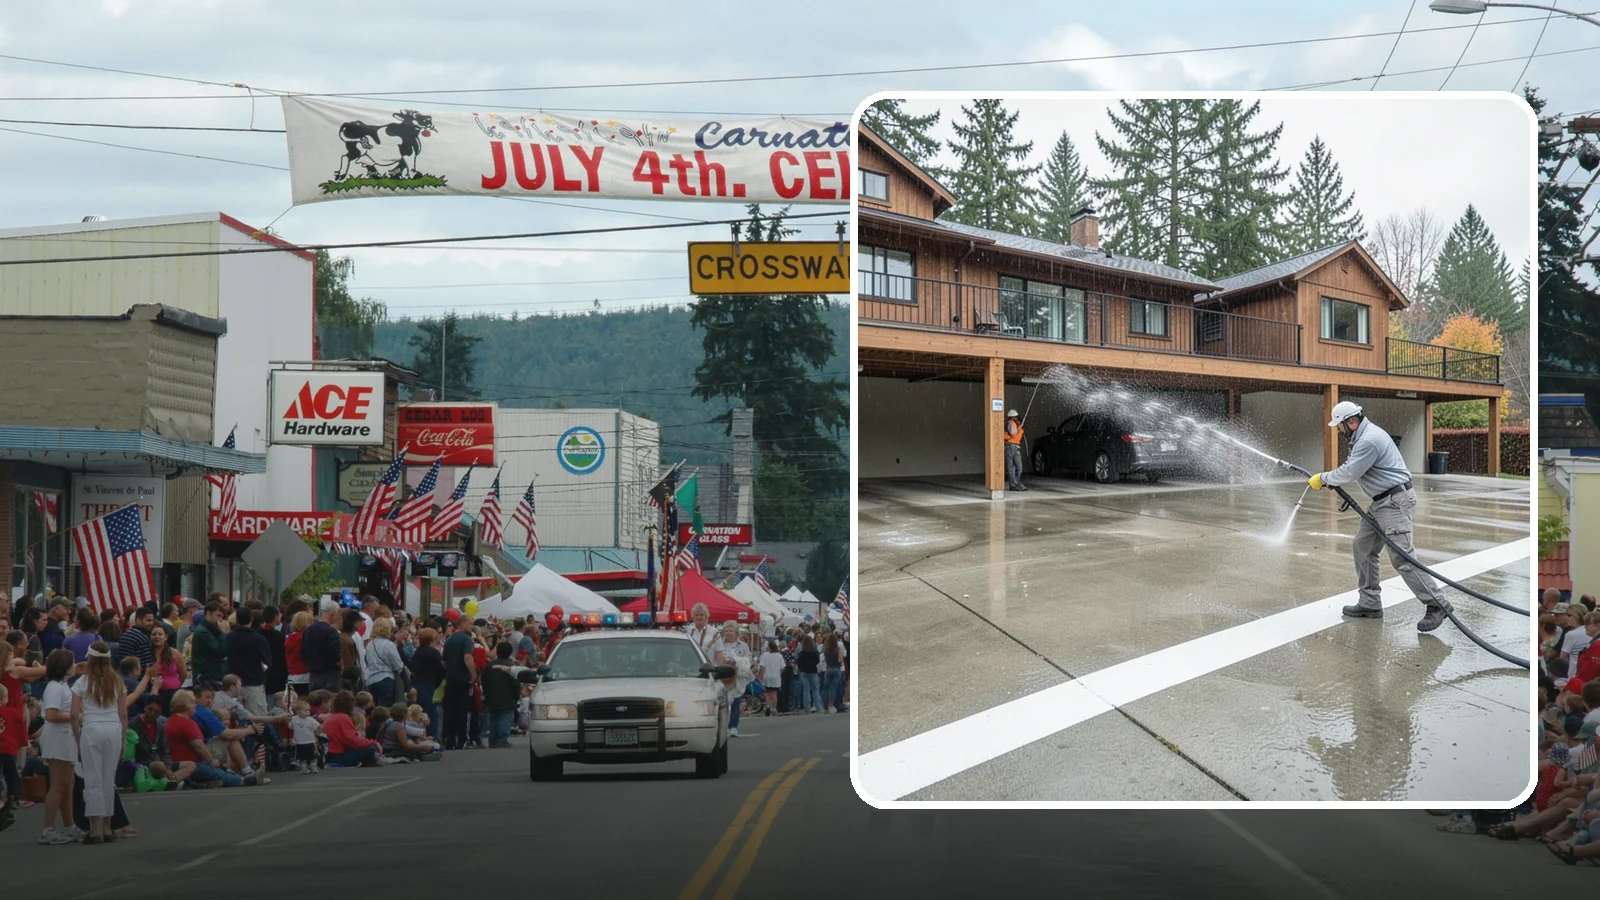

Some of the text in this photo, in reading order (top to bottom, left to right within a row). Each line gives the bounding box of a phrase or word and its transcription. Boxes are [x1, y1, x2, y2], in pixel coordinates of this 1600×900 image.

[695, 121, 850, 149] Carnat
[481, 141, 604, 192] JULY
[632, 150, 746, 198] 4th.
[697, 254, 850, 280] CROSSWA
[283, 380, 373, 420] ACE
[406, 410, 485, 421] CEDAR LOG
[283, 421, 371, 436] Hardware
[353, 467, 385, 480] Simpl
[95, 485, 124, 494] Vincent
[126, 486, 135, 494] de
[137, 486, 155, 495] Paul
[688, 526, 741, 535] CRNATION
[699, 535, 730, 543] GLASS
